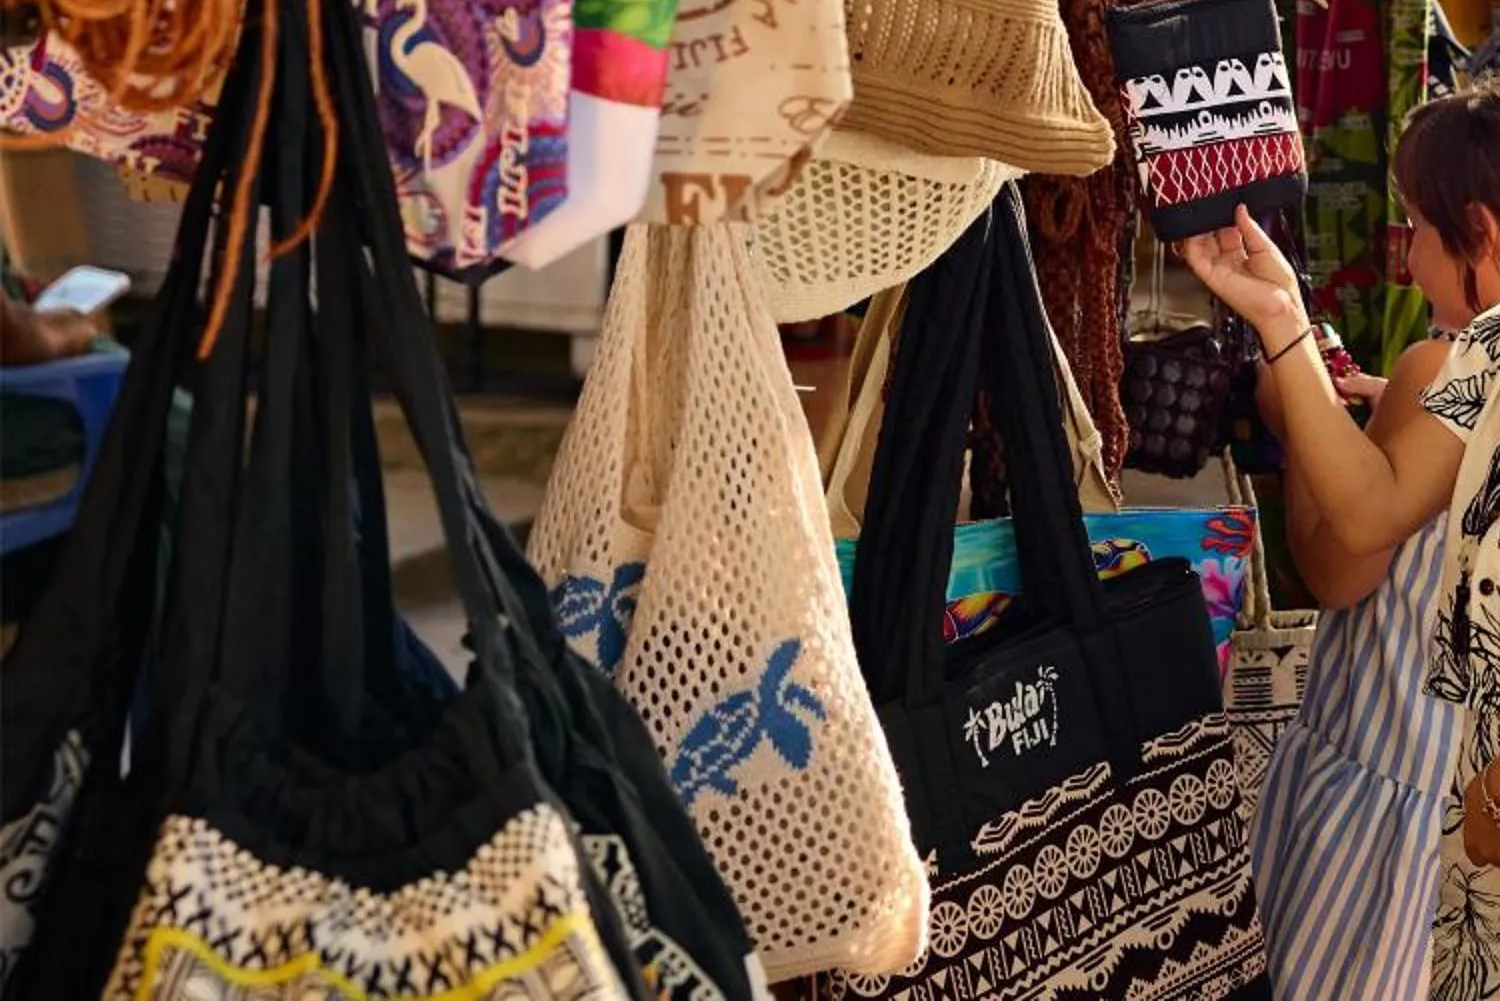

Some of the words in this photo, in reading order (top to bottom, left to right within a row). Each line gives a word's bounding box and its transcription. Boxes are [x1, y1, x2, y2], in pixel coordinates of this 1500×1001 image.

[671, 25, 750, 72] FIJI
[984, 681, 1041, 751] Bula
[1012, 718, 1050, 756] FIJI
